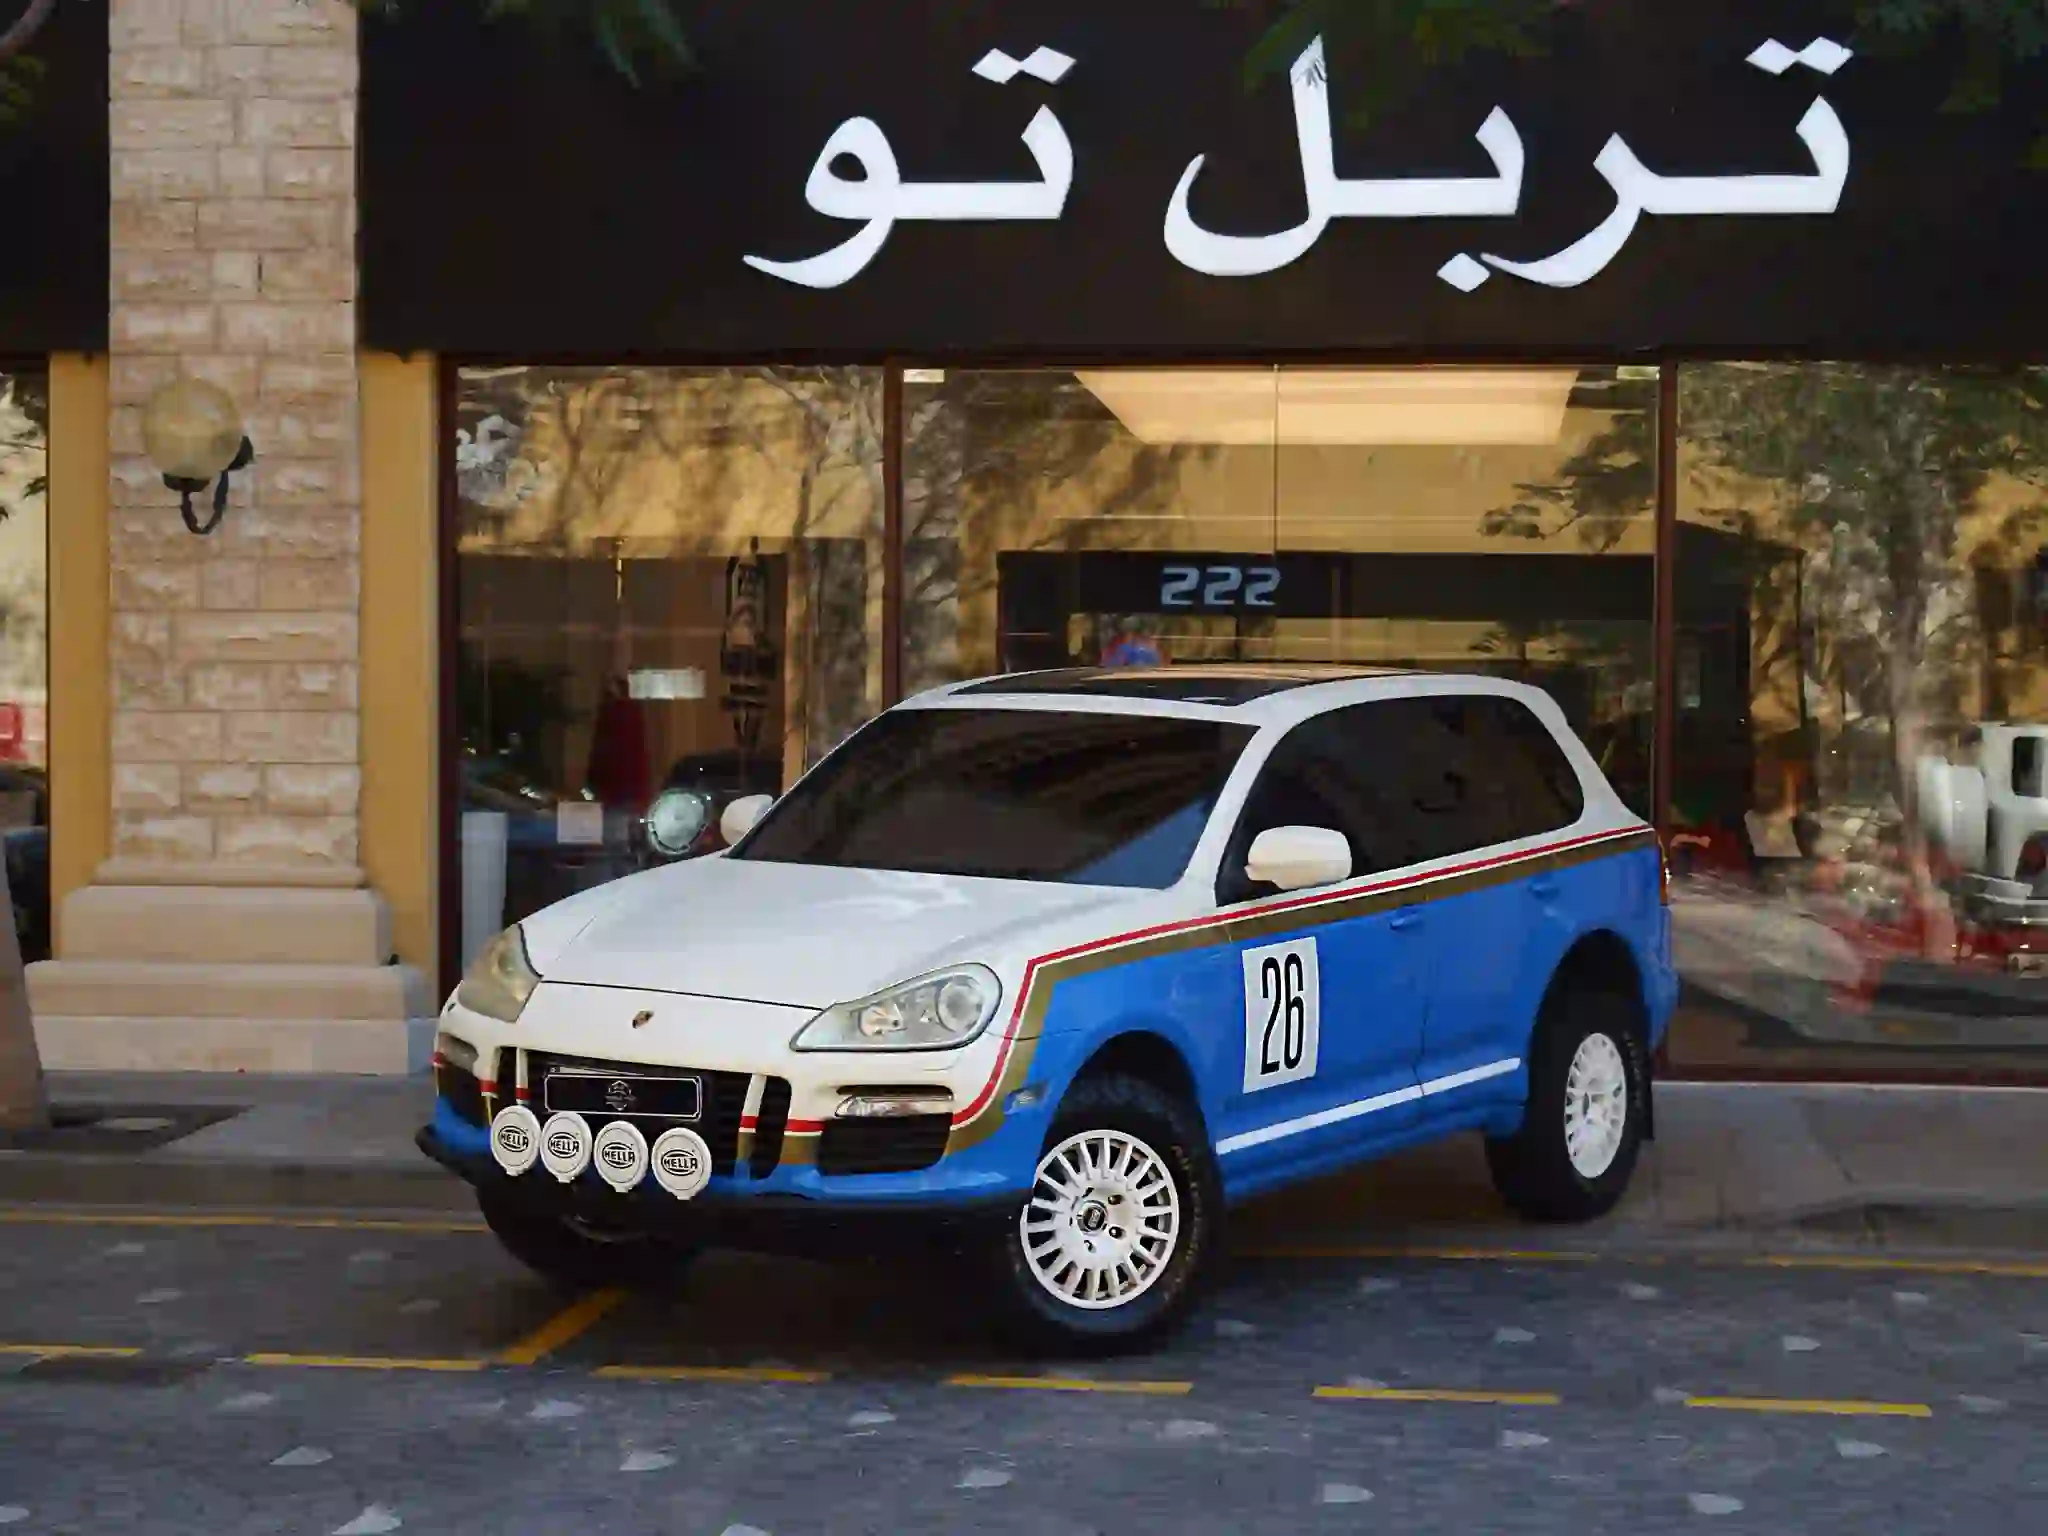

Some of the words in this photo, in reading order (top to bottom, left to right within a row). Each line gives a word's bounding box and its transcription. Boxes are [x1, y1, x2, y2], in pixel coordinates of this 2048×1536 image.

[743, 46, 1076, 288] تو
[1163, 35, 1852, 293] تربل
[1161, 566, 1281, 606] 222
[1260, 952, 1304, 1075] 26
[500, 1132, 529, 1148] HELLA
[550, 1138, 580, 1153] HELLA
[604, 1150, 635, 1163] HELLA
[663, 1156, 698, 1169] HELLA
